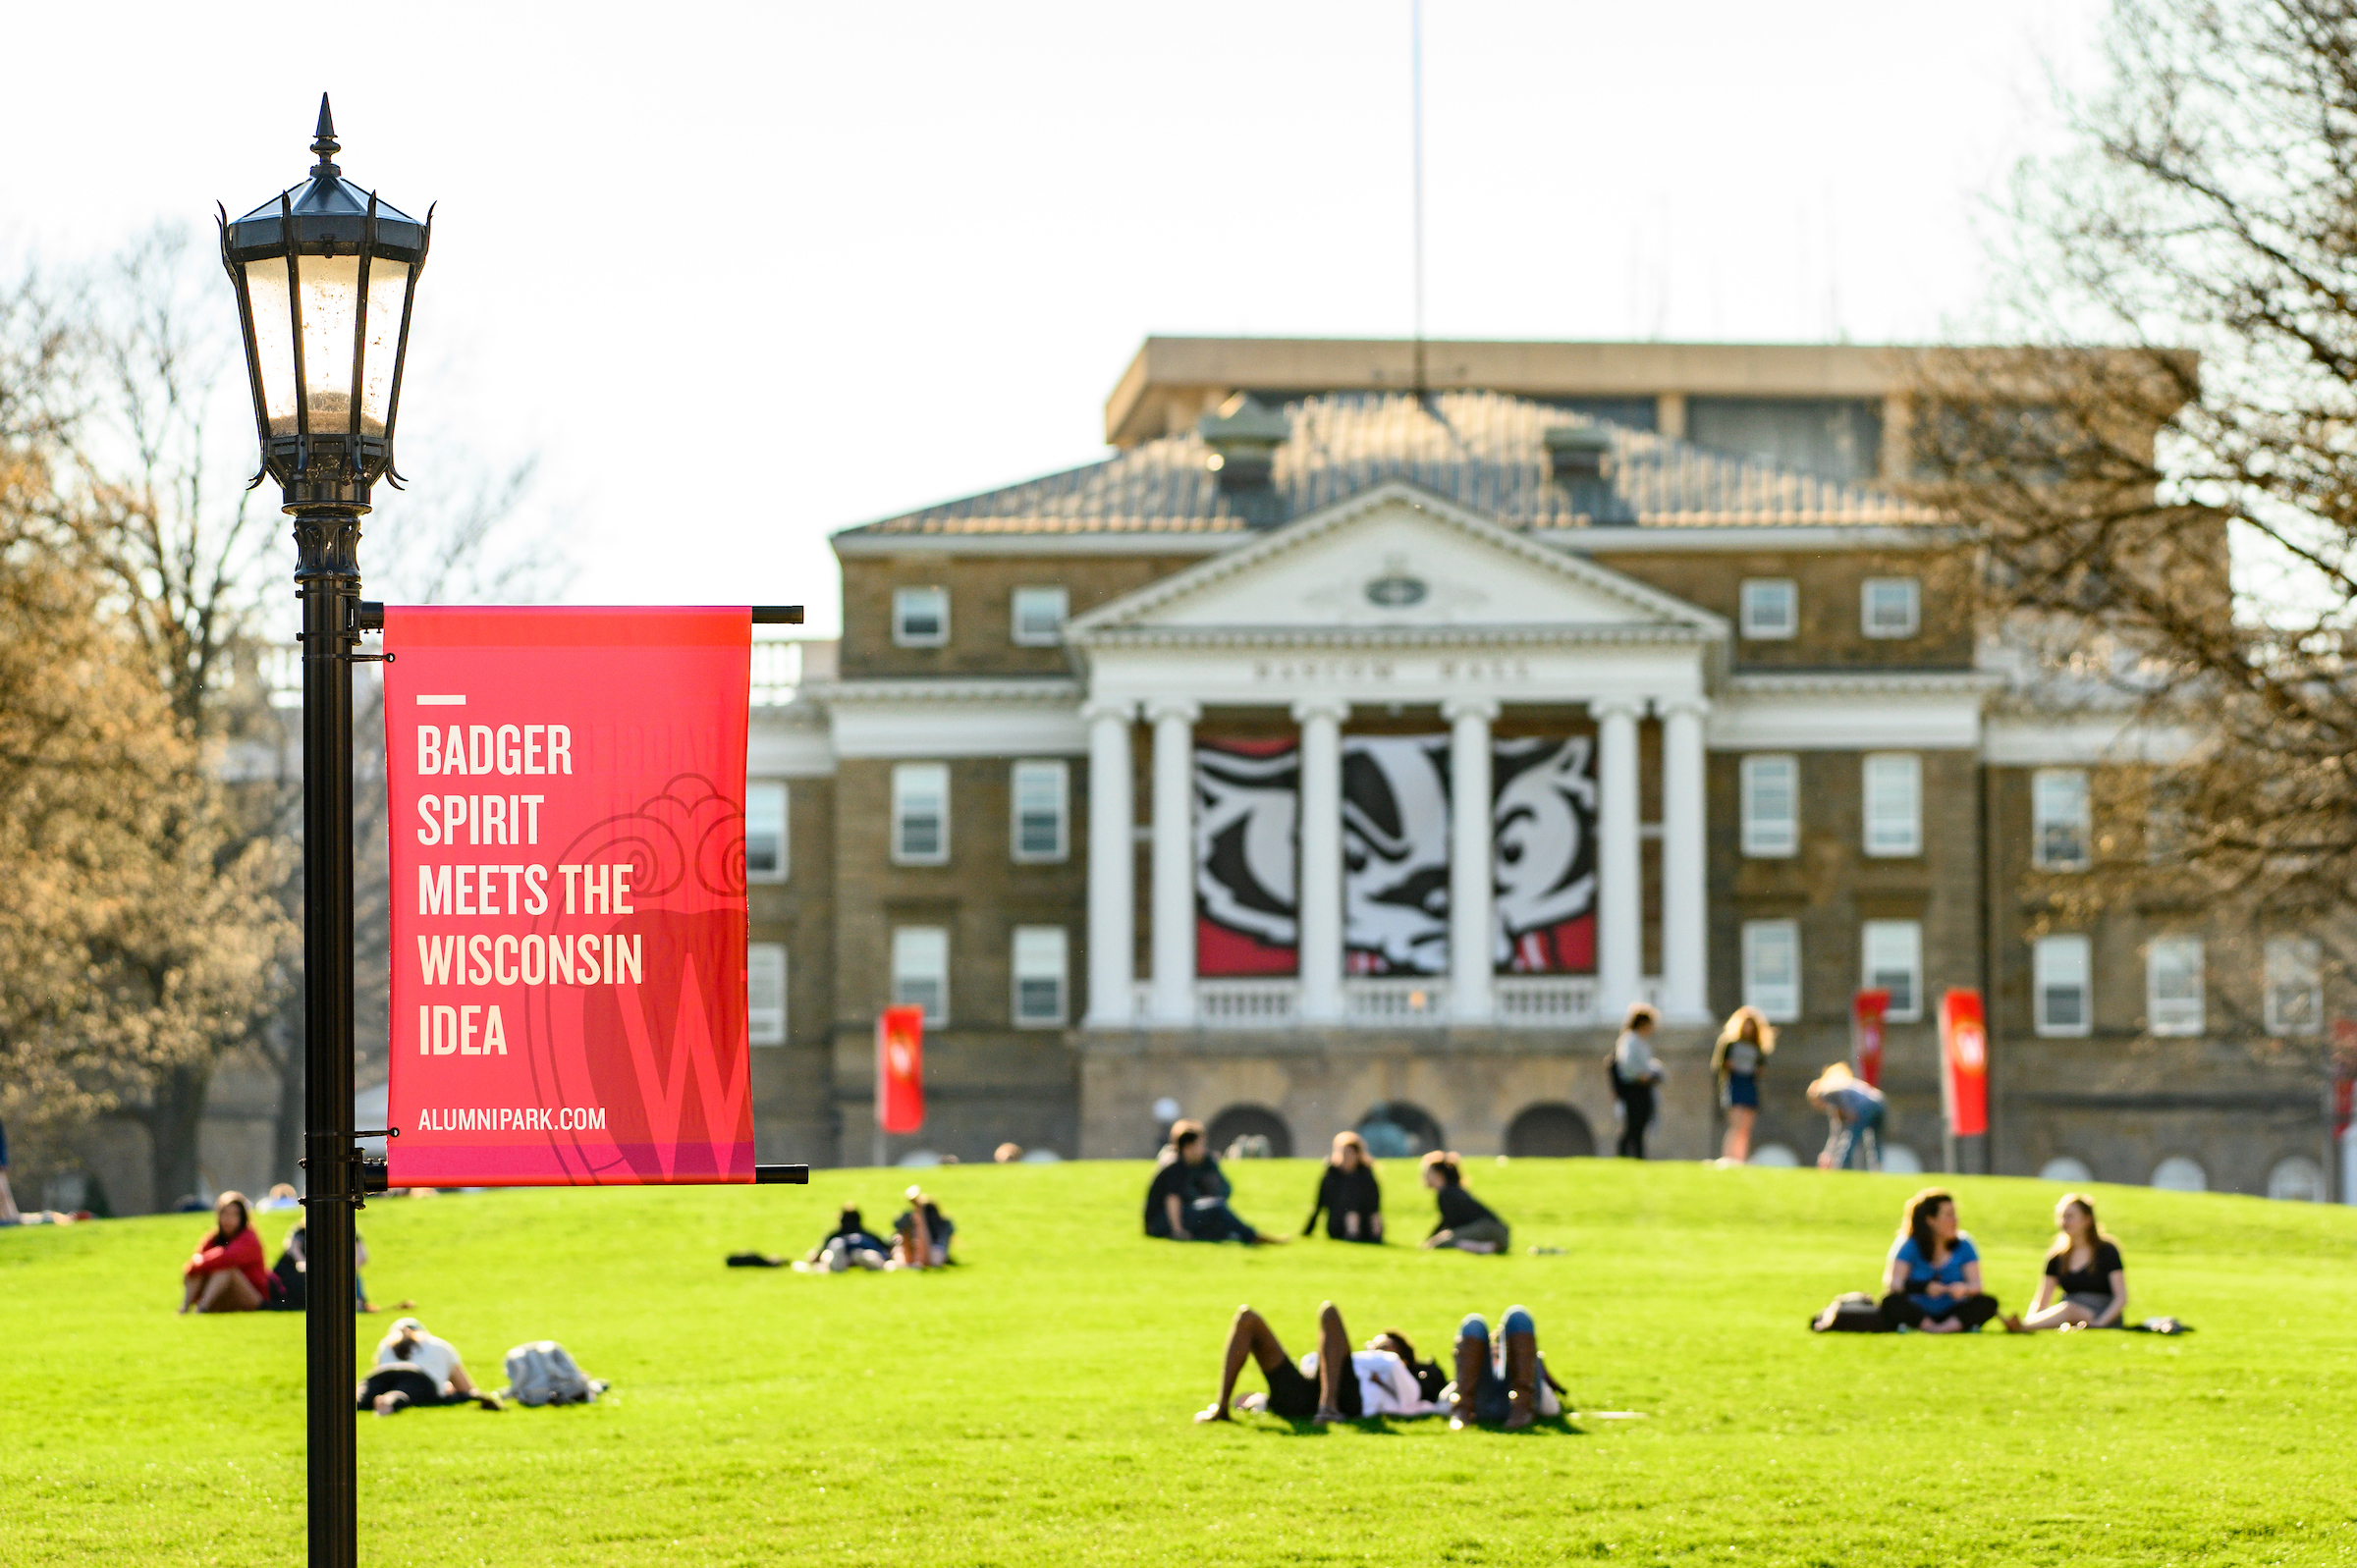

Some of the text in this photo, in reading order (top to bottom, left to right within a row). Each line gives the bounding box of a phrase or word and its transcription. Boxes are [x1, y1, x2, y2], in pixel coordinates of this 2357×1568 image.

[417, 724, 573, 776] BADGER
[417, 794, 545, 846] SPIRIT
[418, 864, 634, 915] MEETS THE
[417, 934, 642, 986] WISCONSIN
[419, 1005, 508, 1055] IDEA
[612, 952, 752, 1182] W
[417, 1108, 606, 1131] ALUMNIPARK.COM
